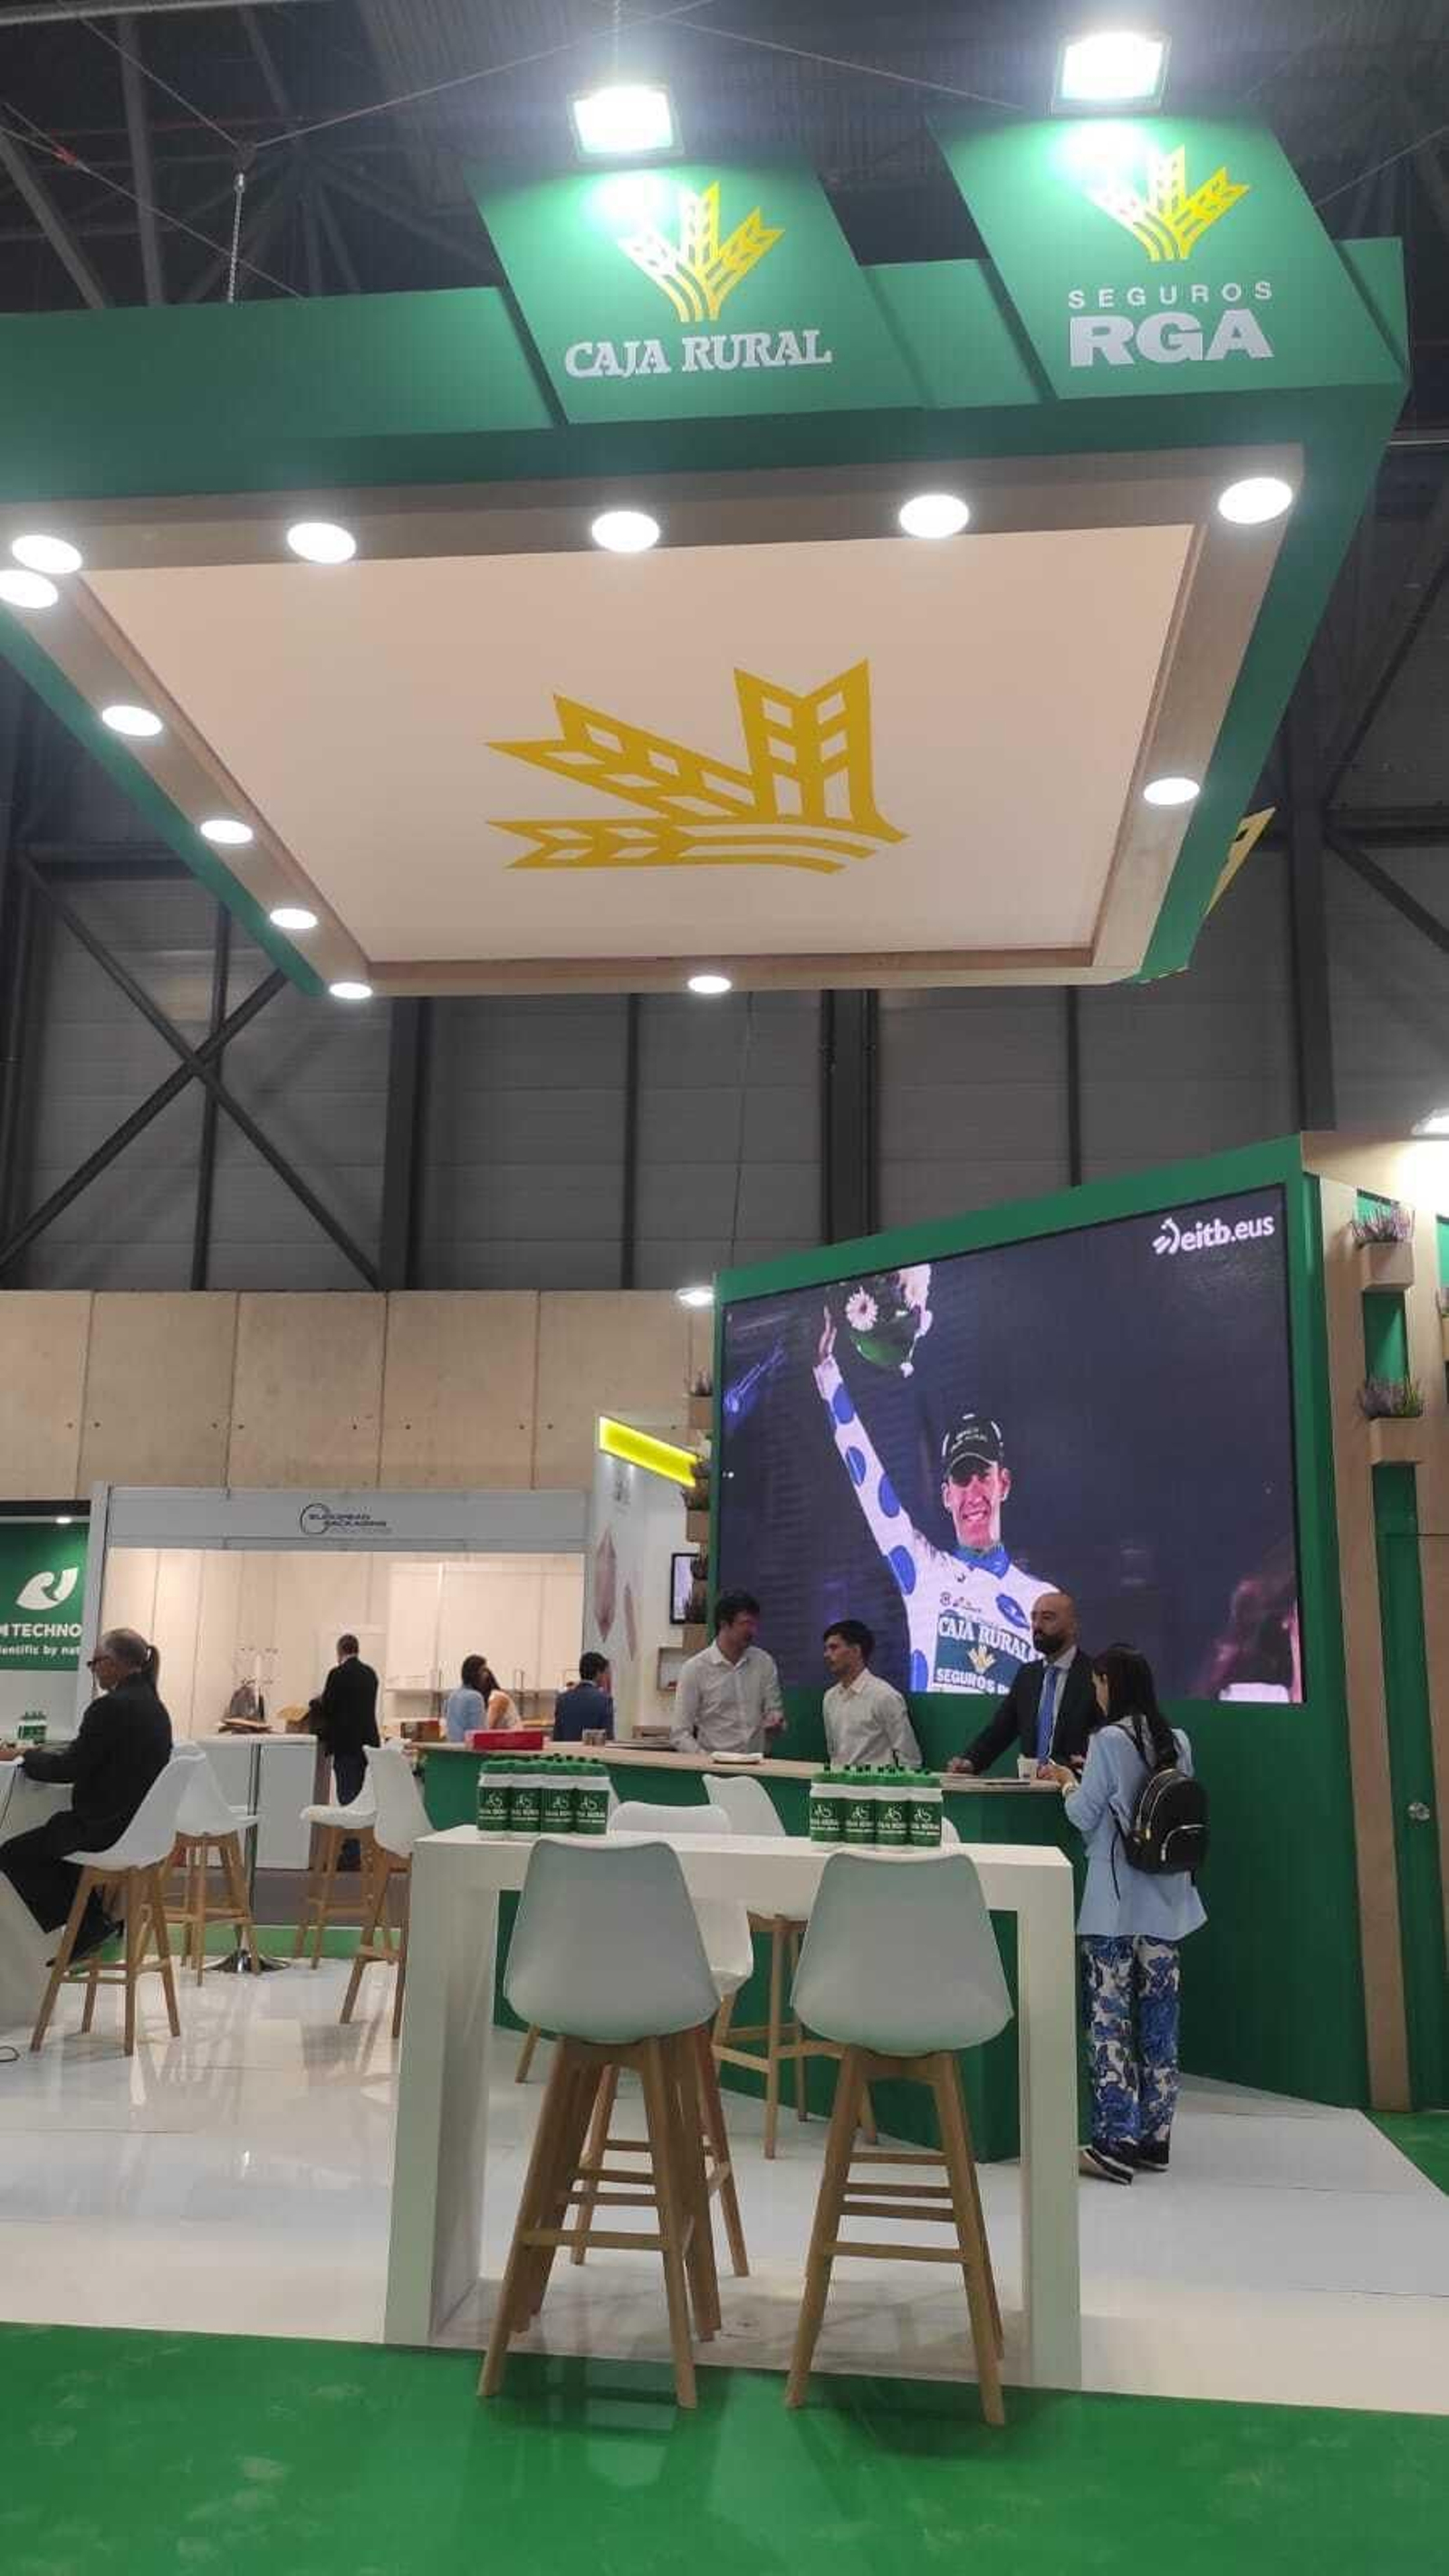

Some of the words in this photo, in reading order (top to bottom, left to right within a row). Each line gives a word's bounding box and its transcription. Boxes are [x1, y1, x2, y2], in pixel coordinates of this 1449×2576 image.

[1068, 281, 1272, 309] SEGUROS
[565, 339, 671, 379] CAJA
[681, 329, 832, 372] RURAL
[1070, 308, 1274, 368] RGA
[1180, 1216, 1275, 1252] eitb.eus
[939, 1617, 974, 1641] CAJA
[978, 1624, 1031, 1663] RURAL
